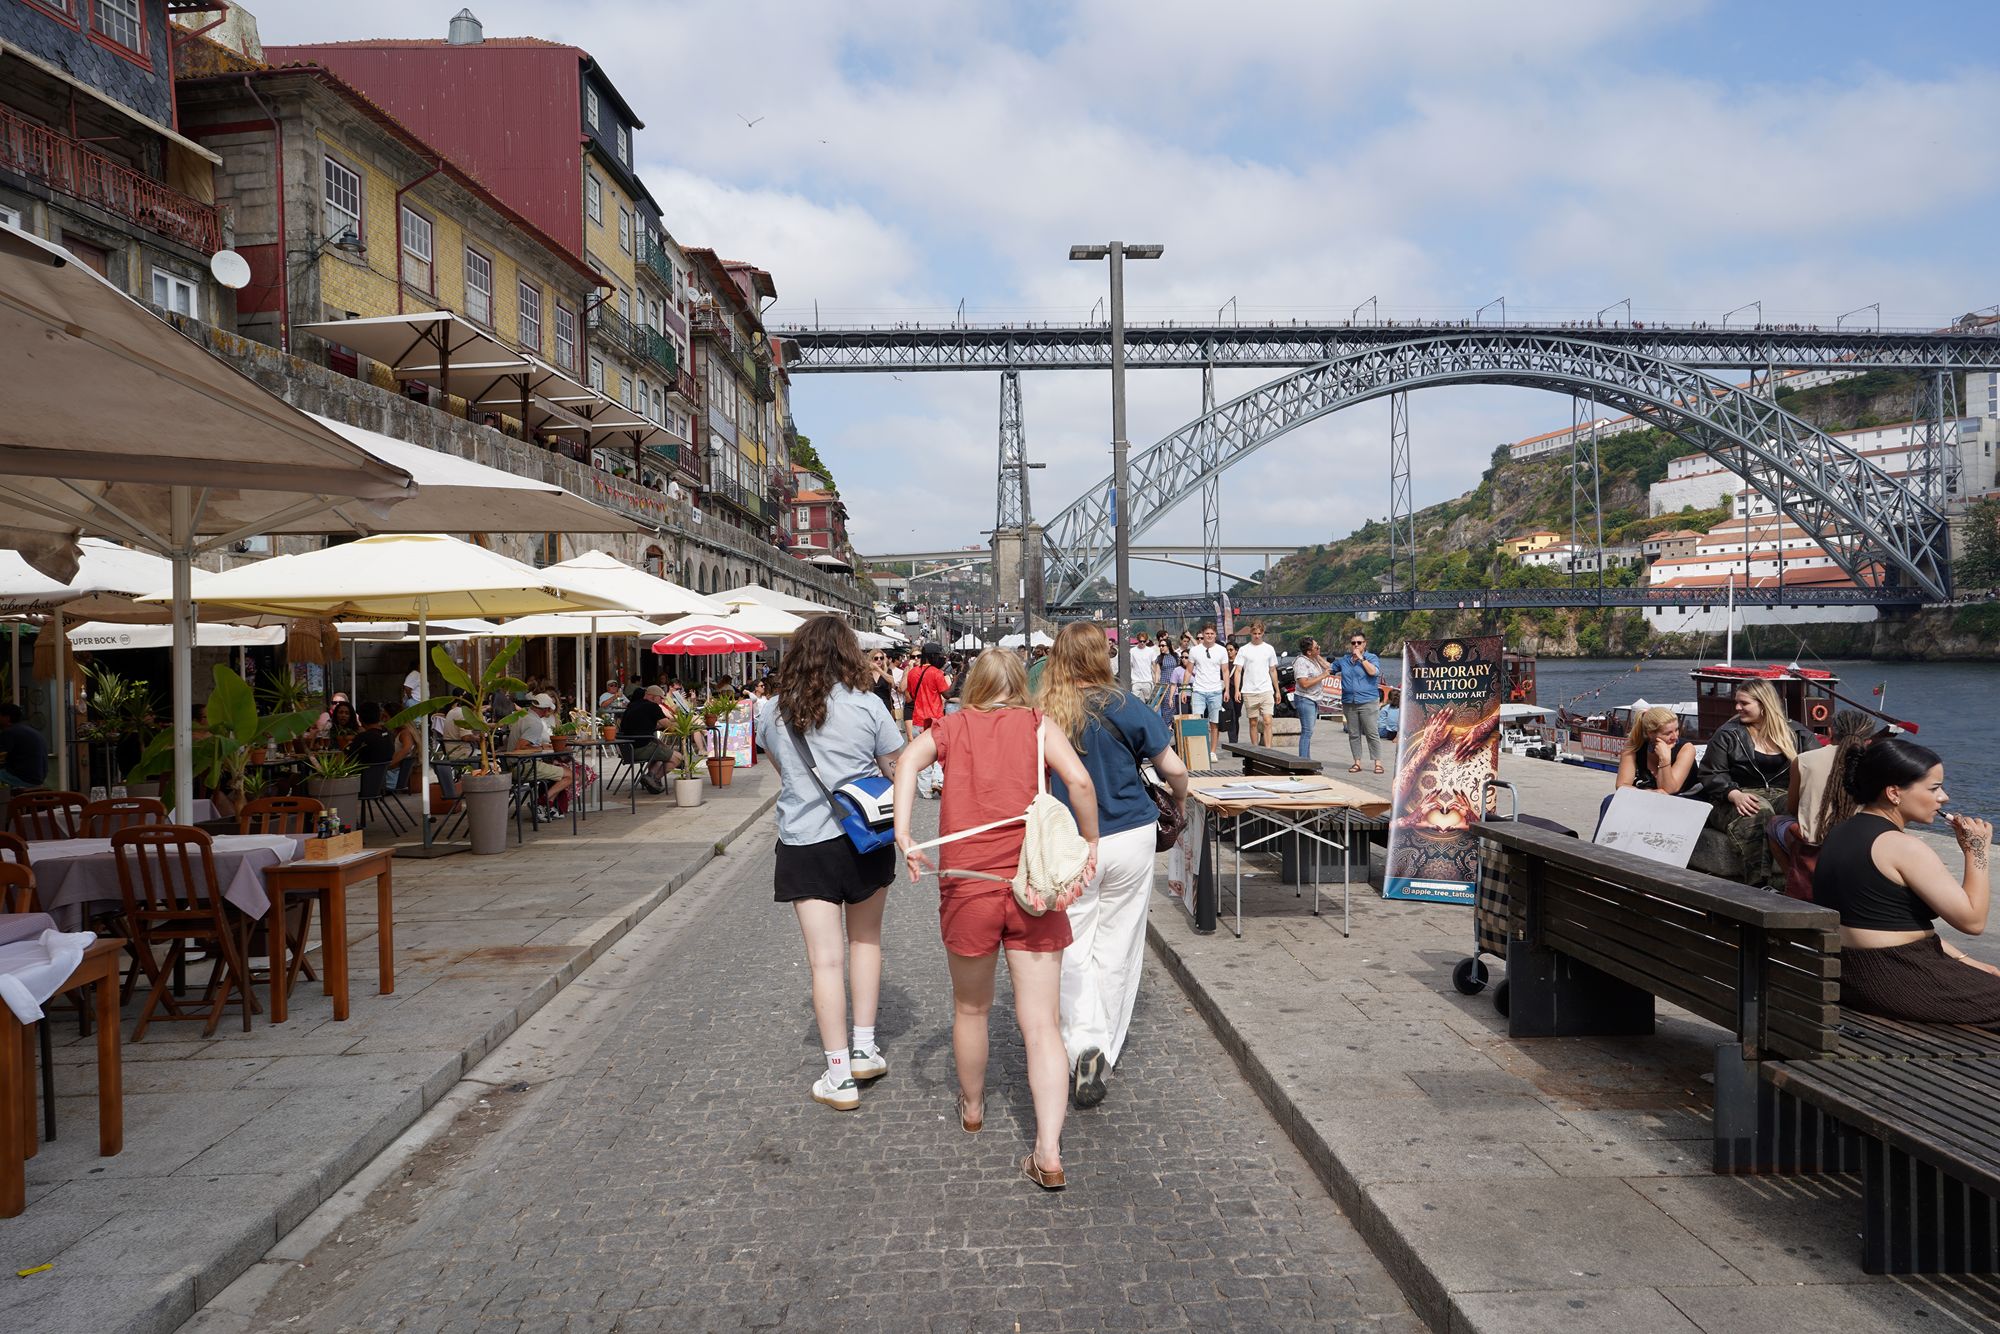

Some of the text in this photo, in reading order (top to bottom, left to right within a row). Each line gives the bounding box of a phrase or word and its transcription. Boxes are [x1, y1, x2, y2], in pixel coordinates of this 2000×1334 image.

[71, 637, 93, 645] UPER
[95, 636, 117, 645] BOCK
[1413, 664, 1492, 679] TEMPORARY
[1426, 678, 1478, 691] TATTOO
[1416, 690, 1487, 700] HENNA BODY ART
[1411, 888, 1475, 898] apple_tree_tattoo
